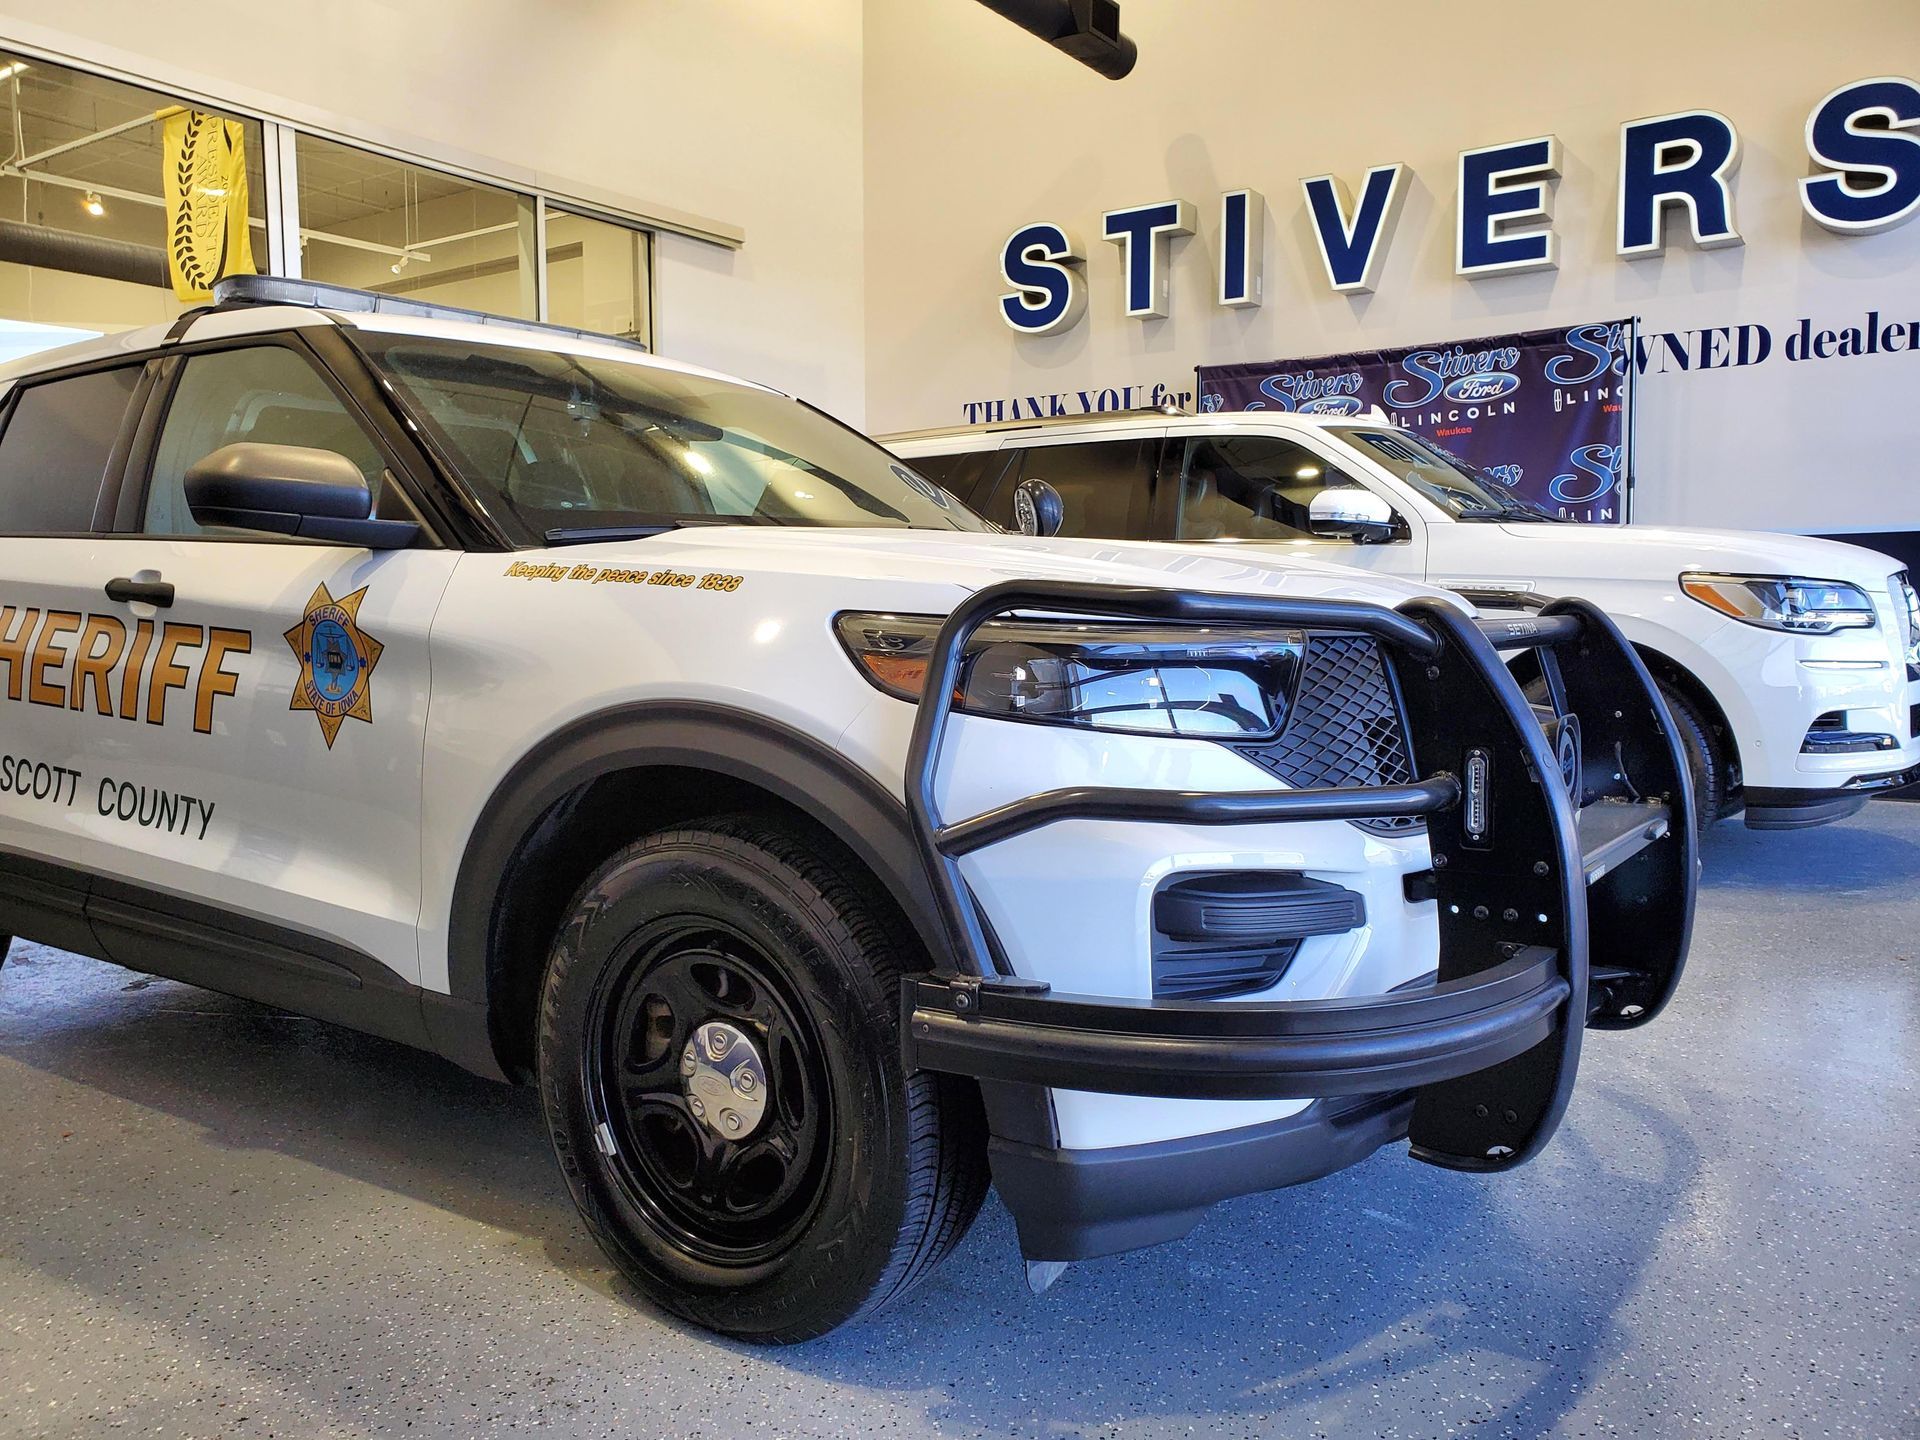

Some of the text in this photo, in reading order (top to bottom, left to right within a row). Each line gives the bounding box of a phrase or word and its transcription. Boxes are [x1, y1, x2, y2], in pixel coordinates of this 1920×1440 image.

[998, 76, 1920, 335] STIVERS
[963, 393, 1068, 424] THANK
[1076, 385, 1144, 414] YOU
[1150, 383, 1192, 411] for
[1623, 324, 1772, 376] WNED
[1383, 344, 1521, 408] Stivers
[1454, 376, 1503, 400] Ford
[1244, 370, 1364, 413] Stivers
[1311, 403, 1350, 417] Ford
[1401, 401, 1516, 428] LINCOLN
[1436, 426, 1473, 438] Waukee
[504, 560, 744, 593] Keeping the peace since 1838
[309, 607, 349, 627] SHERIFF
[1507, 623, 1538, 636] SETINA
[306, 680, 360, 715] STATE OF IOWA
[0, 754, 216, 841] SCOTT COUNTY
